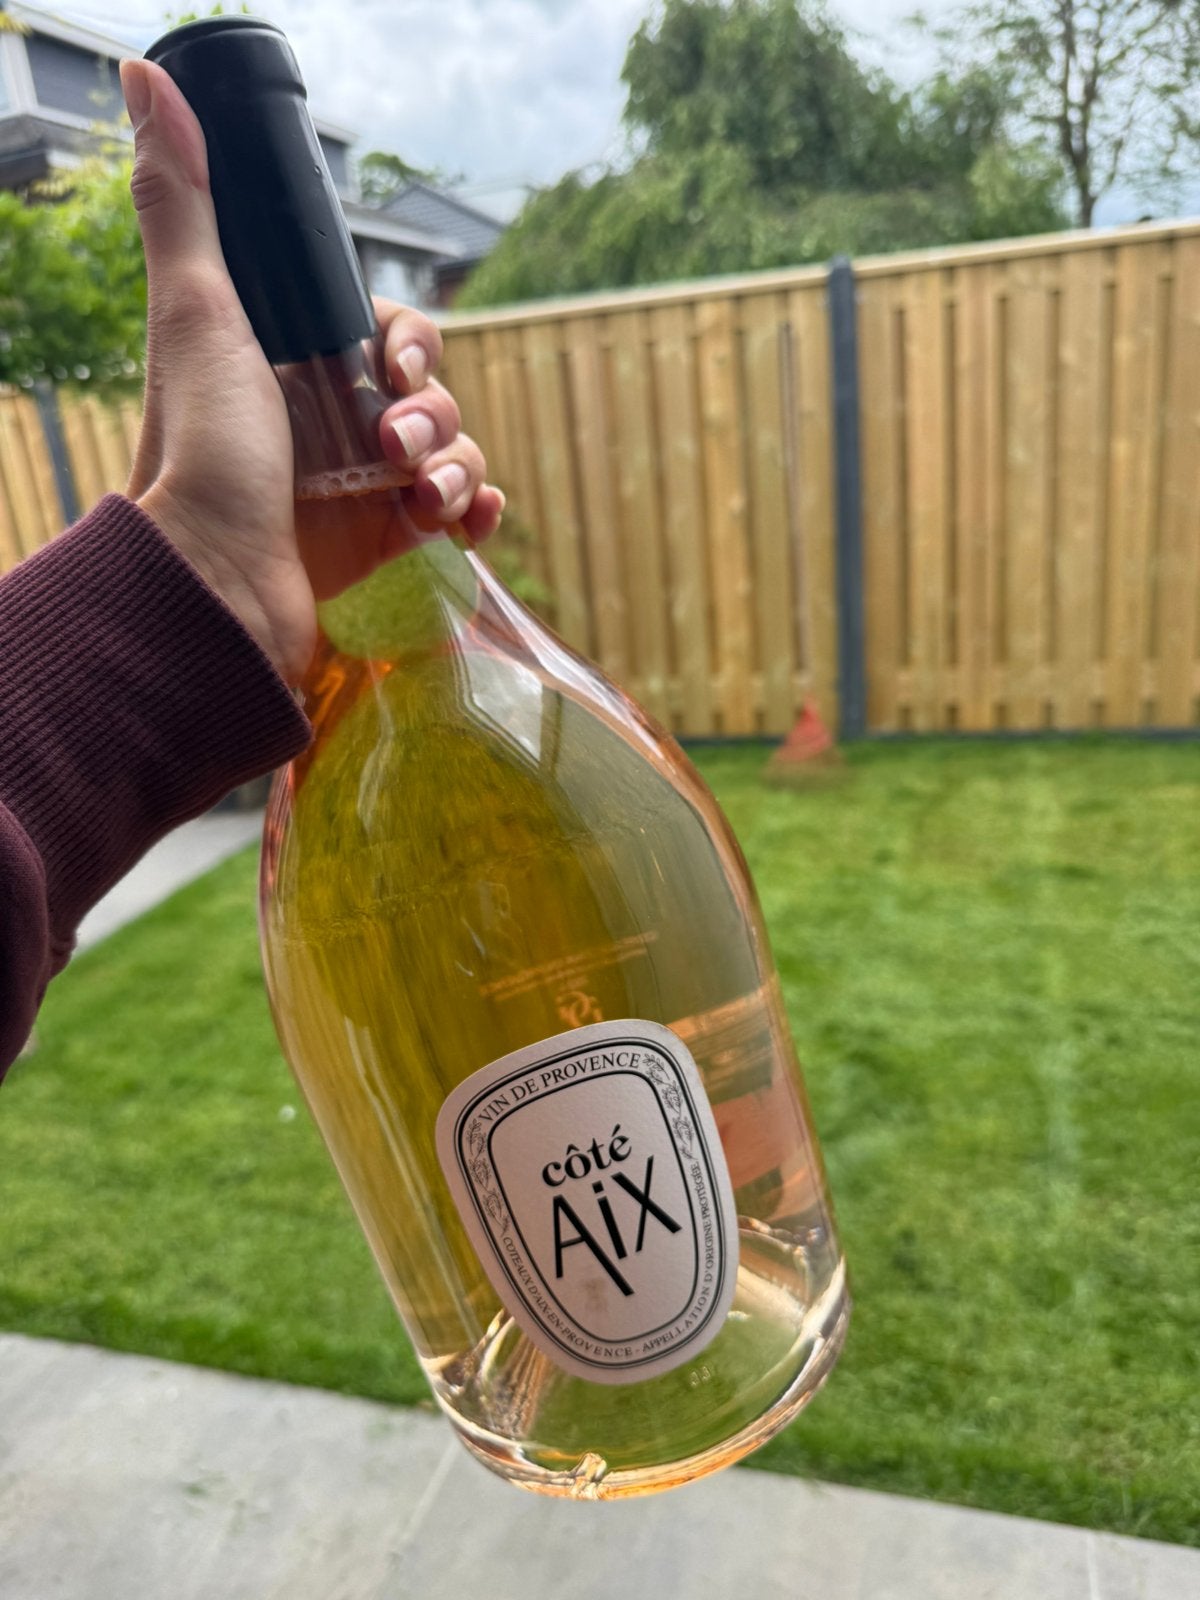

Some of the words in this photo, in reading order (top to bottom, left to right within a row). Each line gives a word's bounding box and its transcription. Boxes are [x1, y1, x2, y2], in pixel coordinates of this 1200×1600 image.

[479, 1094, 510, 1124] VIN
[510, 1078, 540, 1101] DE
[540, 1052, 641, 1088] PROVENCE
[541, 1124, 633, 1189] côté
[690, 1160, 711, 1221] PROTÉGÉE
[503, 1236, 533, 1286] COTEAUX
[701, 1218, 714, 1283] D'ORIGINE
[642, 1286, 711, 1353] APPELLATION
